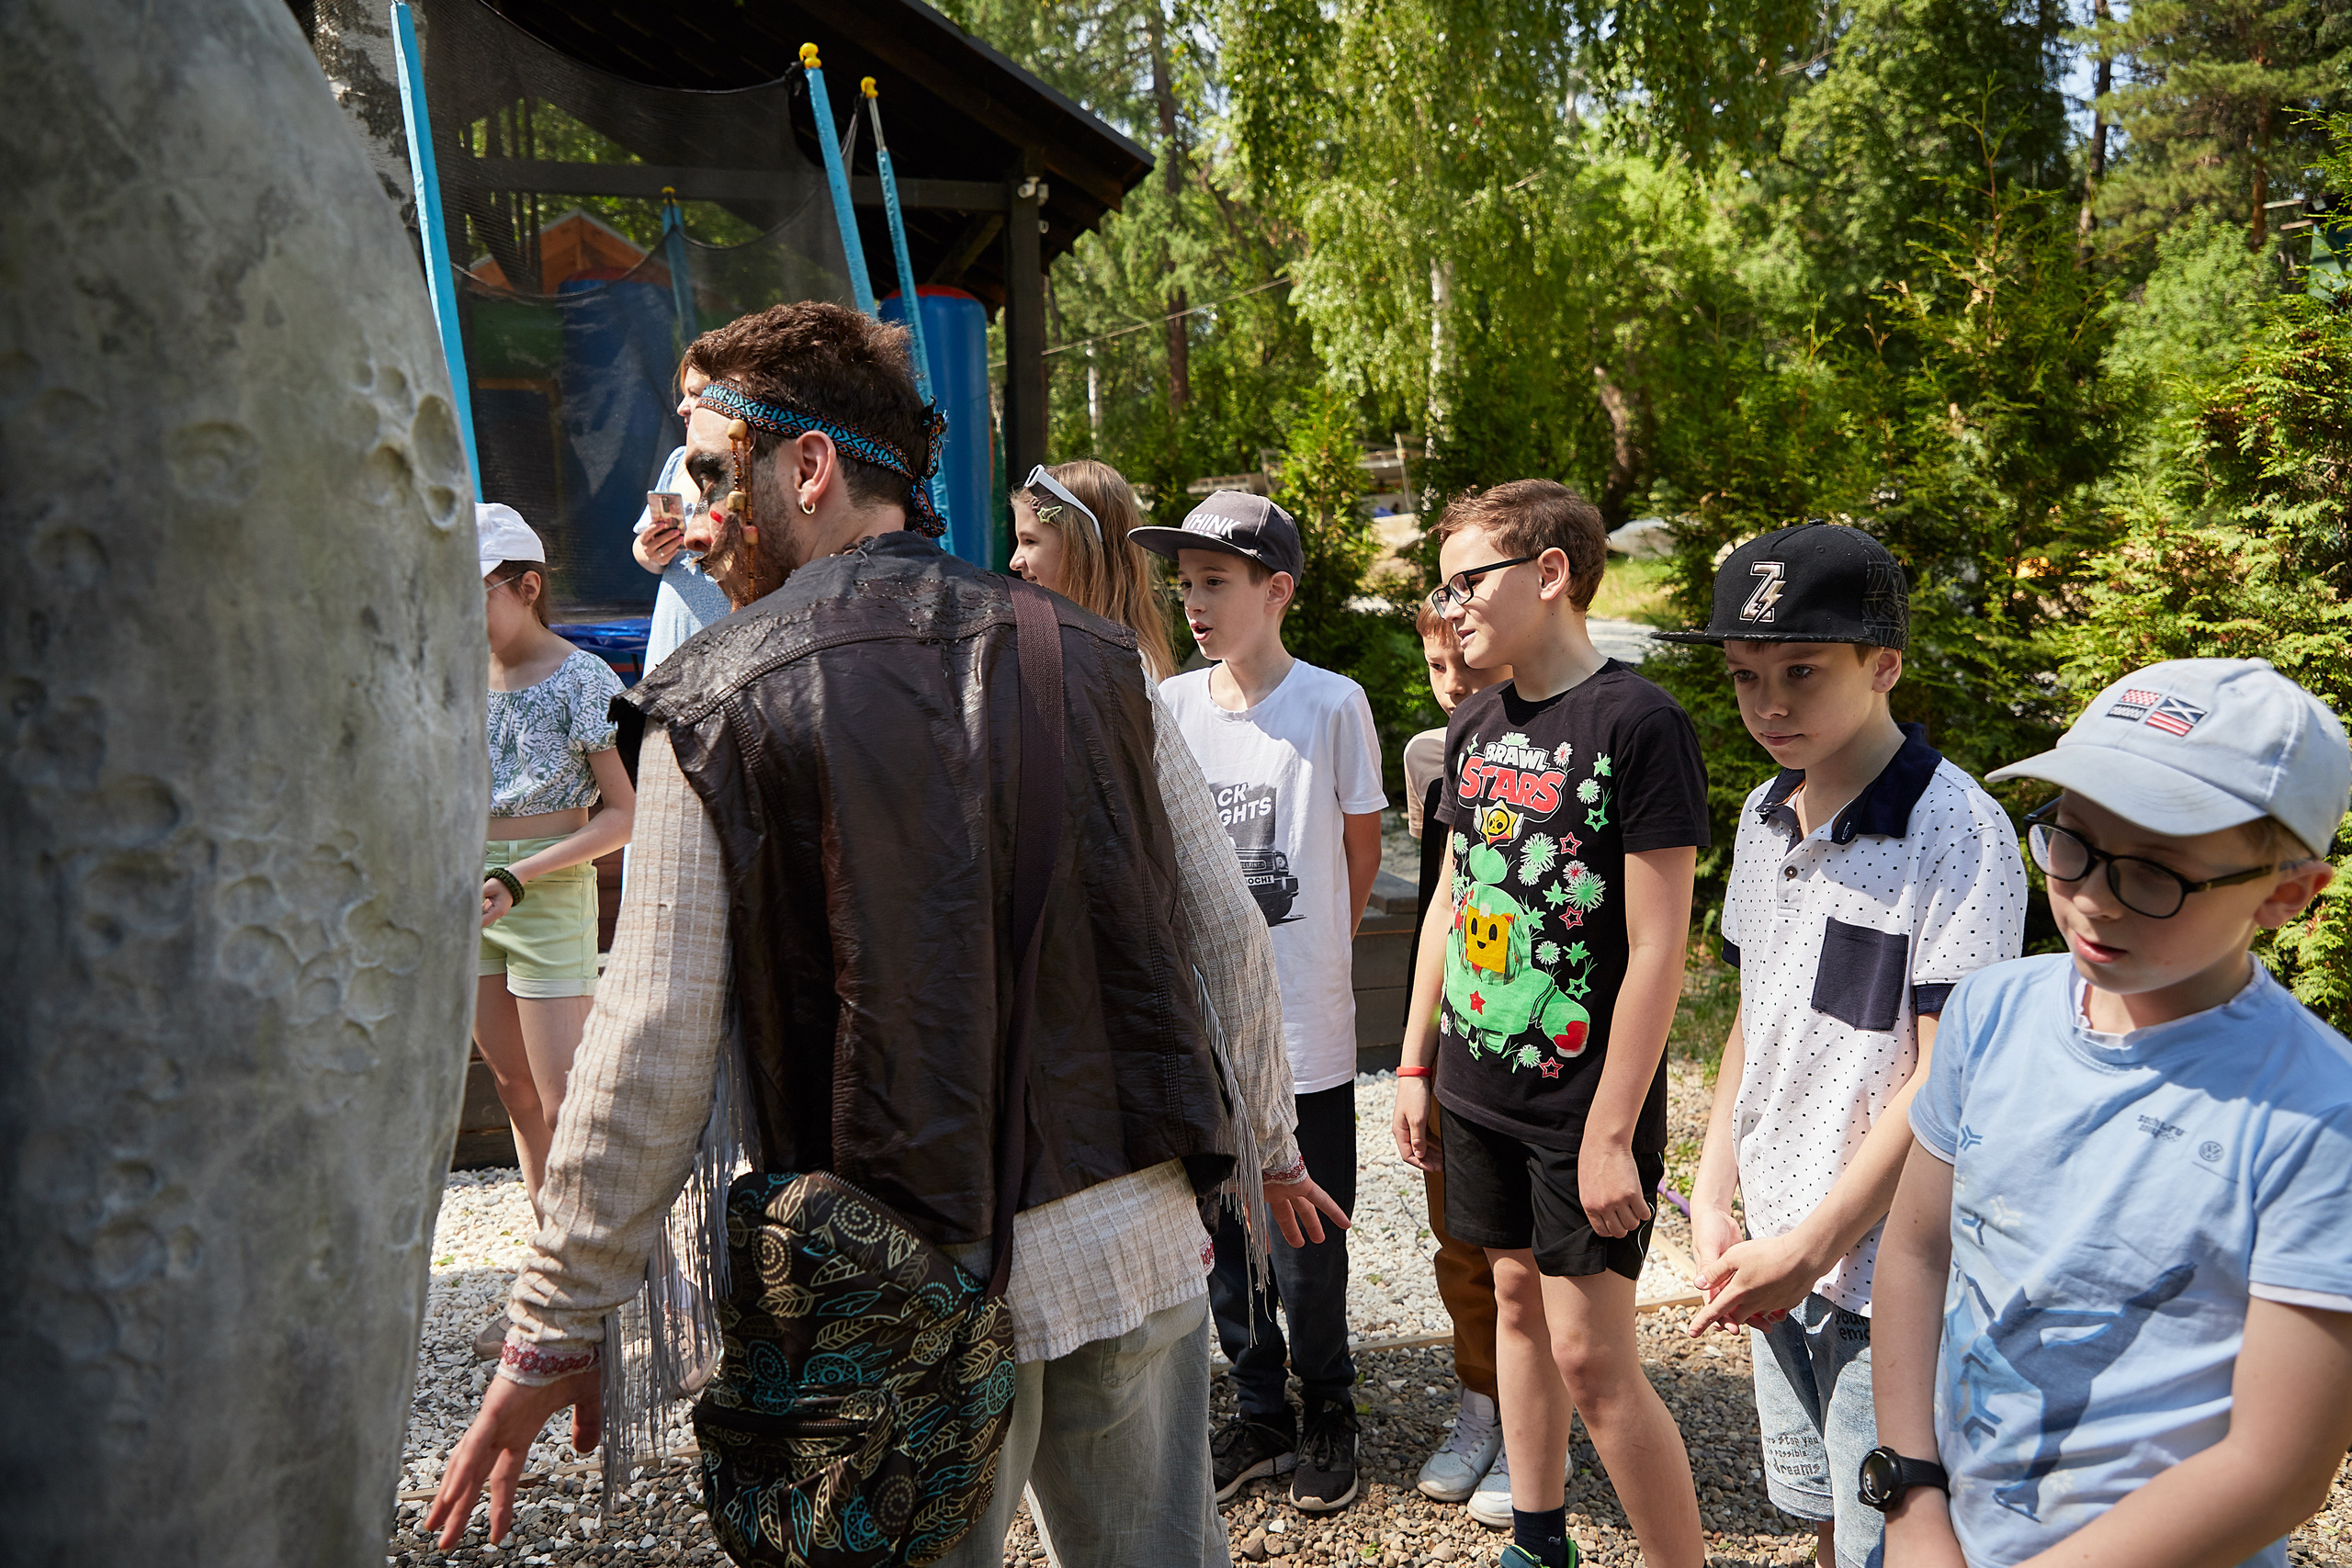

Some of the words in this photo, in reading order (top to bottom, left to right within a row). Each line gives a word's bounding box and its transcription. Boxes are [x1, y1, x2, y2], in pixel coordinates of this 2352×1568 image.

[1185, 513, 1242, 539] THINK
[1485, 743, 1549, 772] BRAWL
[1459, 755, 1565, 813] STARS
[1246, 875, 1272, 885] OCHI
[1801, 1436, 1819, 1448] you
[1773, 1457, 1820, 1476] dreams
